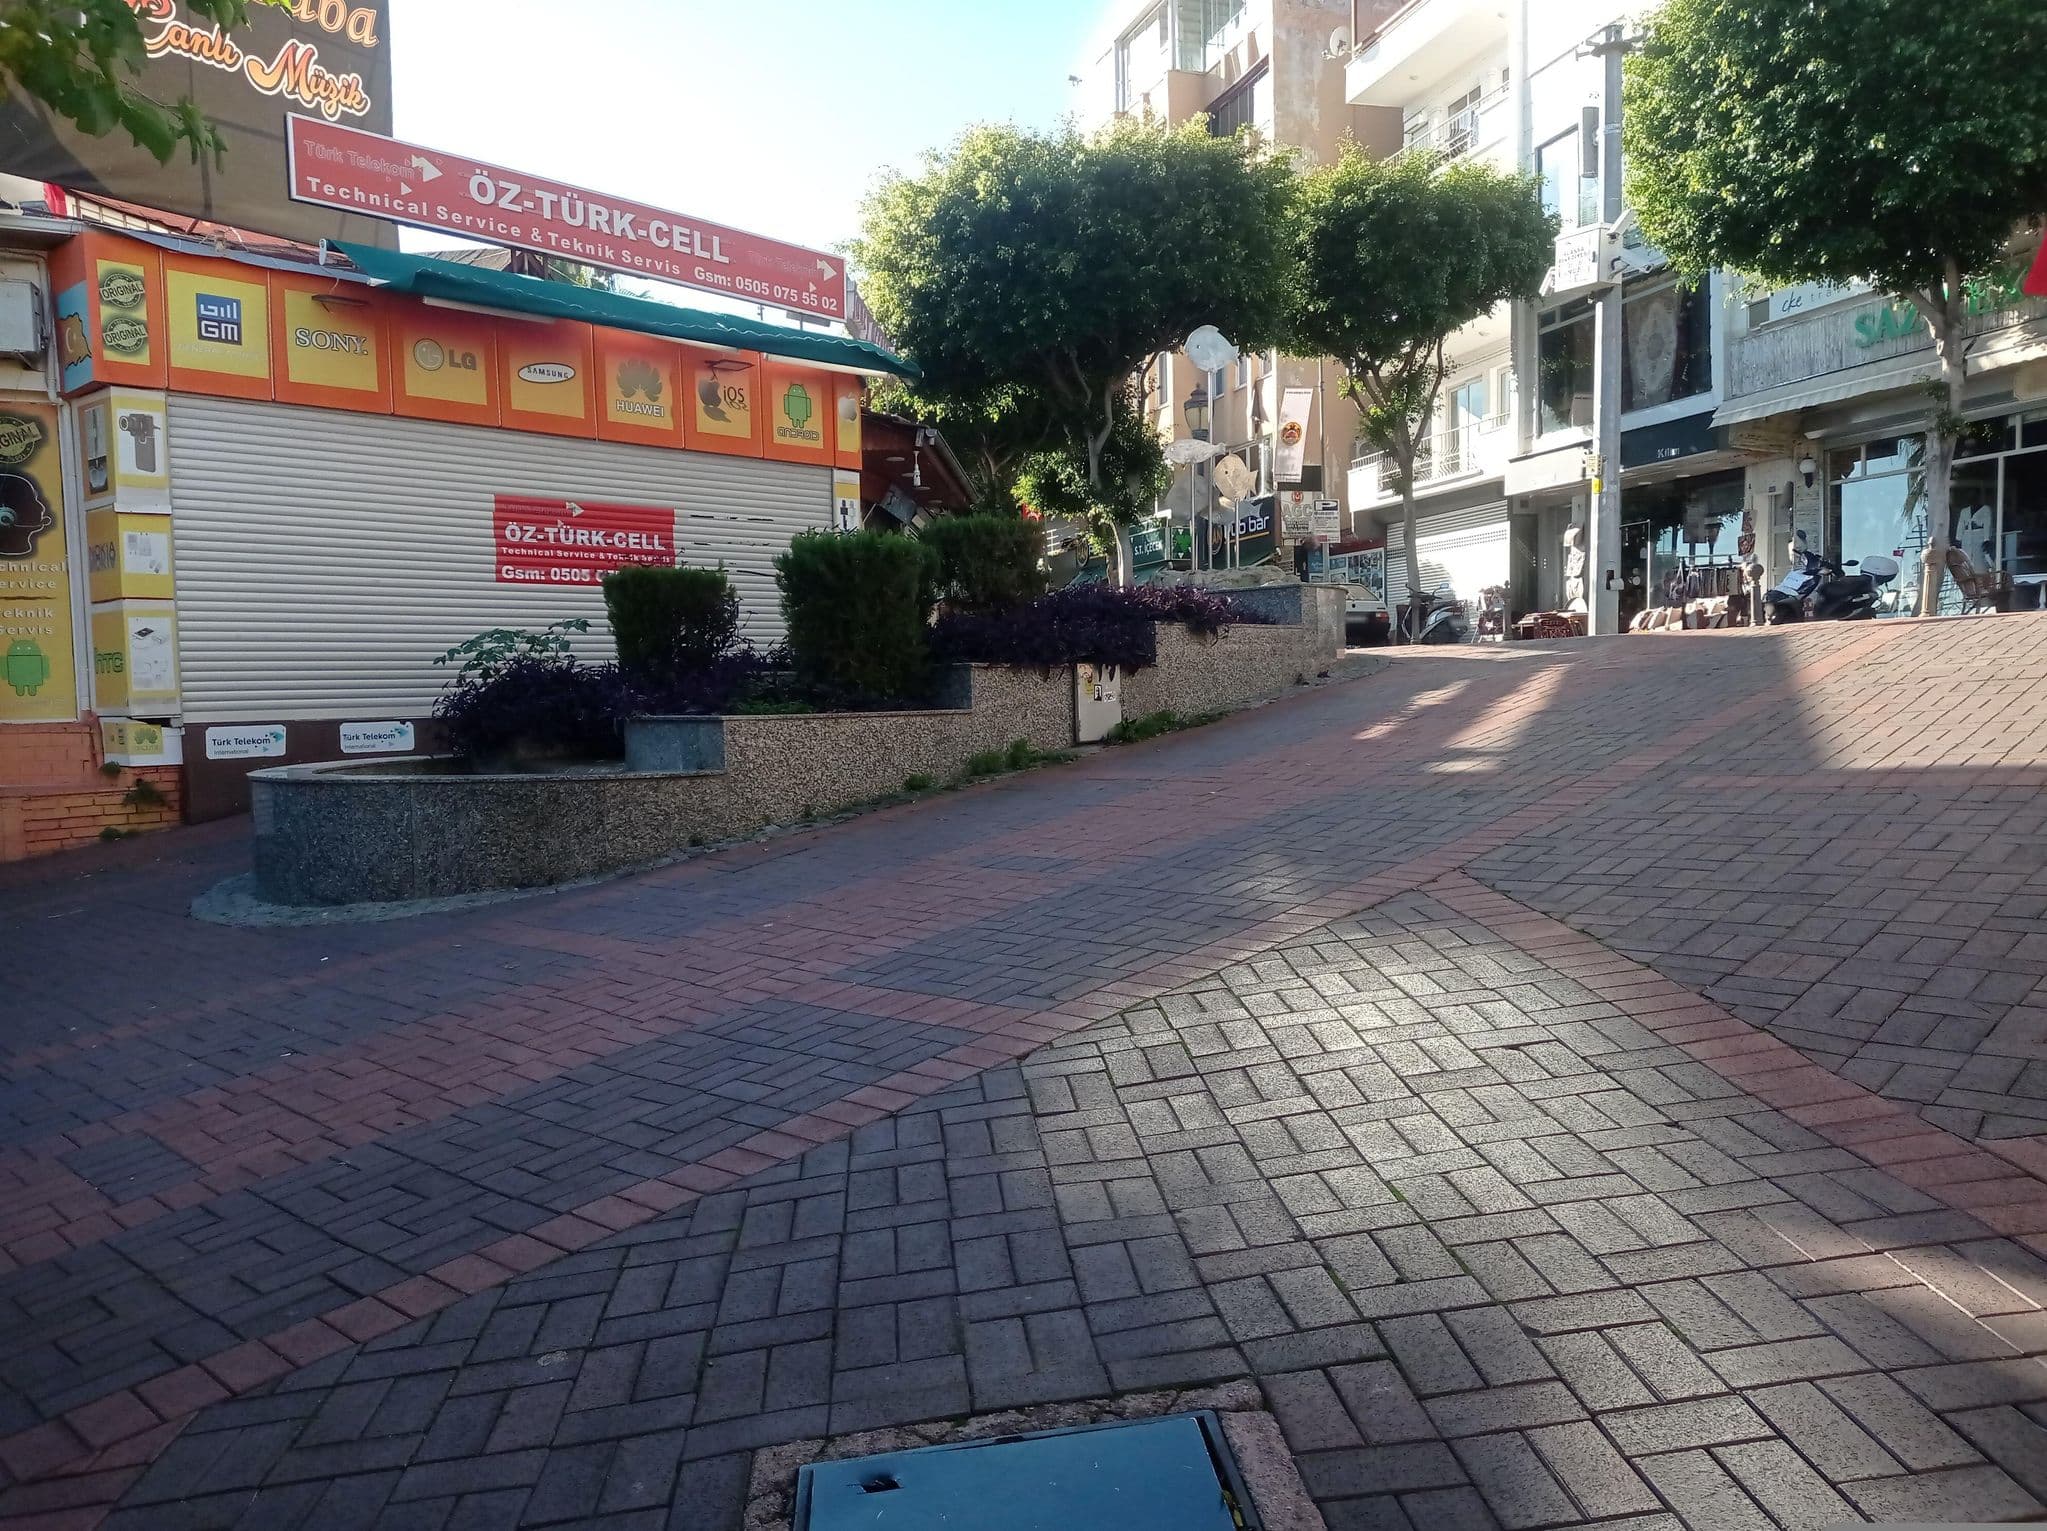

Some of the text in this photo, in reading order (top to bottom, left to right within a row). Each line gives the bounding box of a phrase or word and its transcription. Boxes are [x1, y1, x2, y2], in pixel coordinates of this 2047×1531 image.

[147, 22, 370, 119] anlı Müzik
[304, 140, 344, 163] Türk
[468, 168, 730, 264] ÖZ-TÜRK-CELL
[307, 176, 838, 311] Technical Service & Teknik Servis Gsm: 0505 075 55 02
[101, 282, 143, 299] ORIGINAL
[104, 325, 146, 343] ORIGINAL
[200, 319, 239, 341] GM
[449, 349, 477, 370] LG
[527, 366, 569, 379] SAMSUNG
[723, 385, 745, 403] iOS
[615, 399, 665, 417] HUAWEI
[0, 425, 40, 447] GINAL
[1248, 516, 1270, 532] bar
[505, 522, 666, 551] ÖZ-TÜRK-CELL
[502, 547, 554, 556] Technical
[556, 550, 595, 559] Service
[0, 562, 66, 572] chnical
[502, 566, 546, 581] Gsm:
[551, 567, 591, 582] 0505
[0, 608, 54, 618] eknik
[234, 736, 271, 746] Telekom
[363, 732, 396, 740] Telekom
